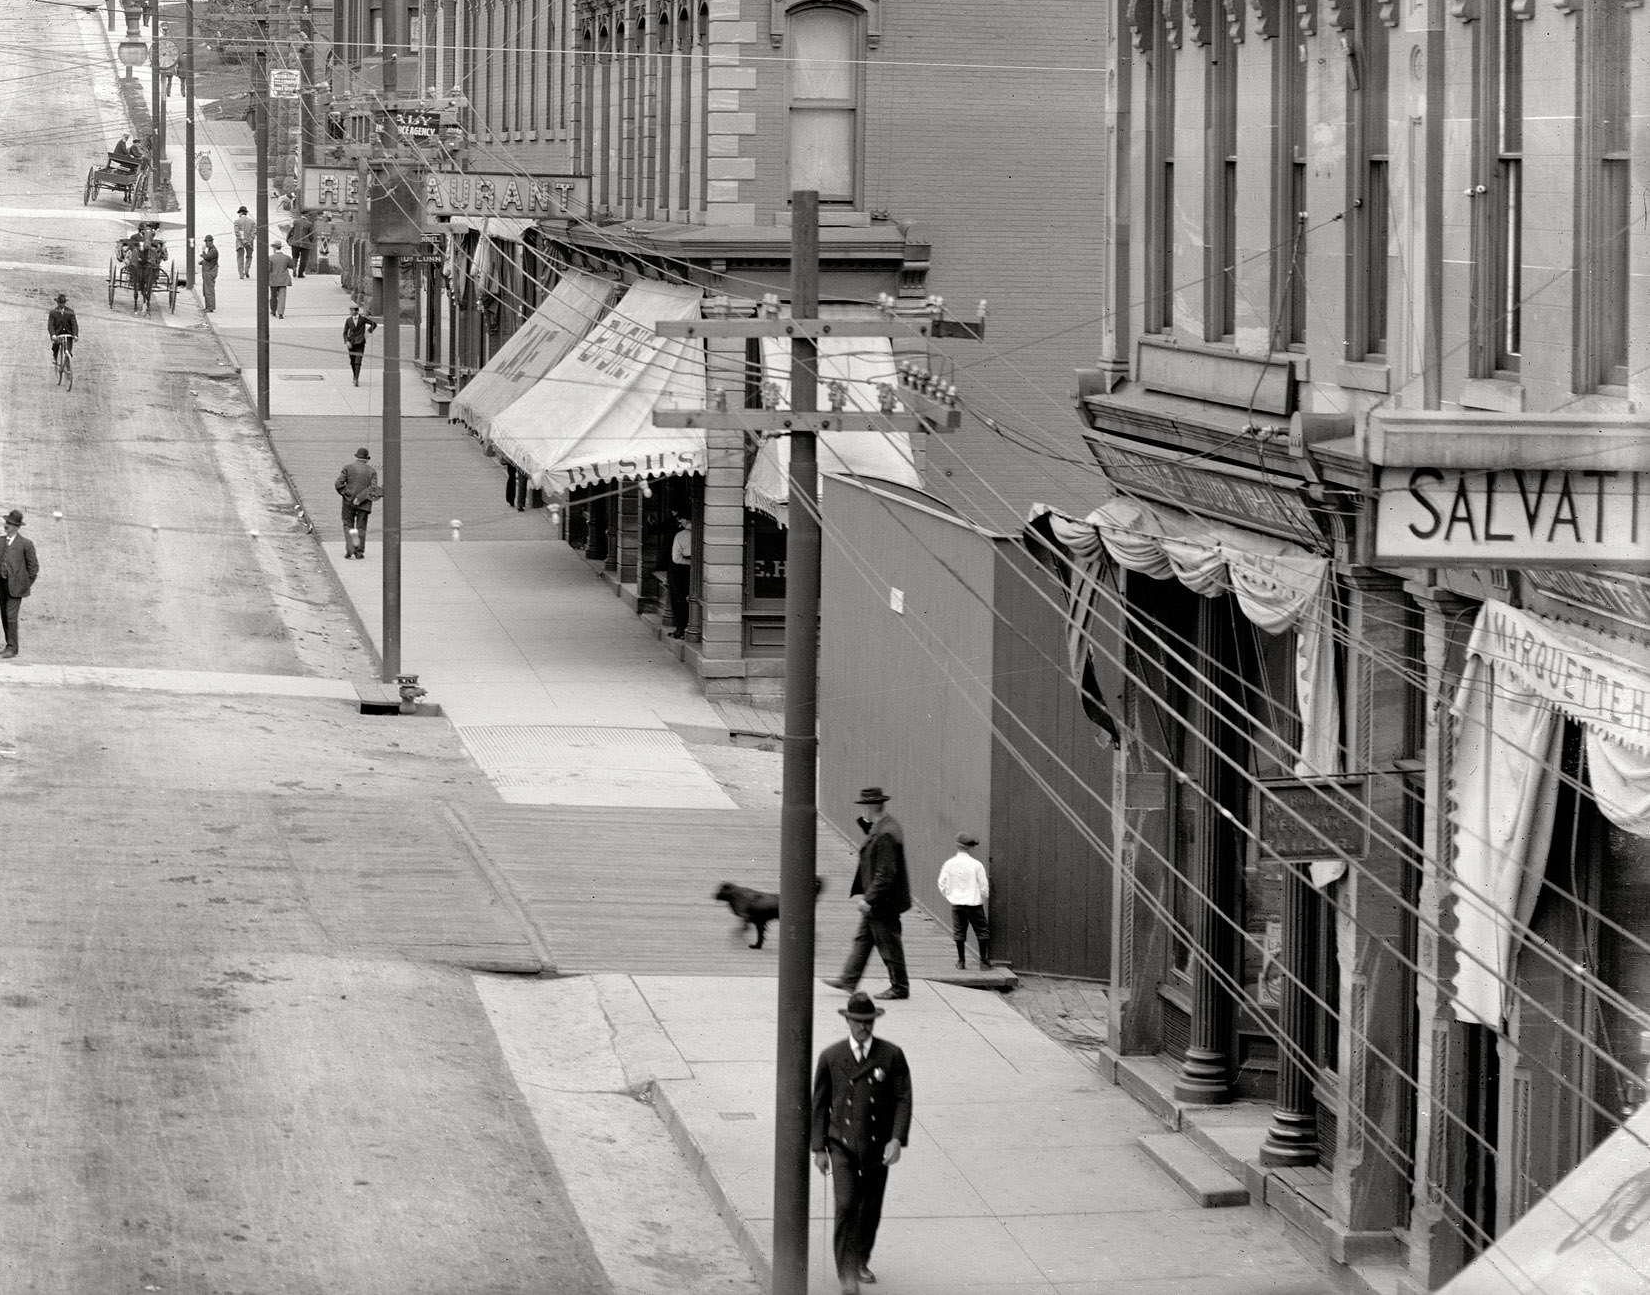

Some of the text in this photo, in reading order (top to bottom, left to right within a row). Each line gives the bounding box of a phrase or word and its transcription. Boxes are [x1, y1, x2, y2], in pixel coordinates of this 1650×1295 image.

[319, 174, 575, 213] REAURANT
[566, 451, 696, 485] BUSH'S
[1494, 611, 1624, 726] MARQUETTE
